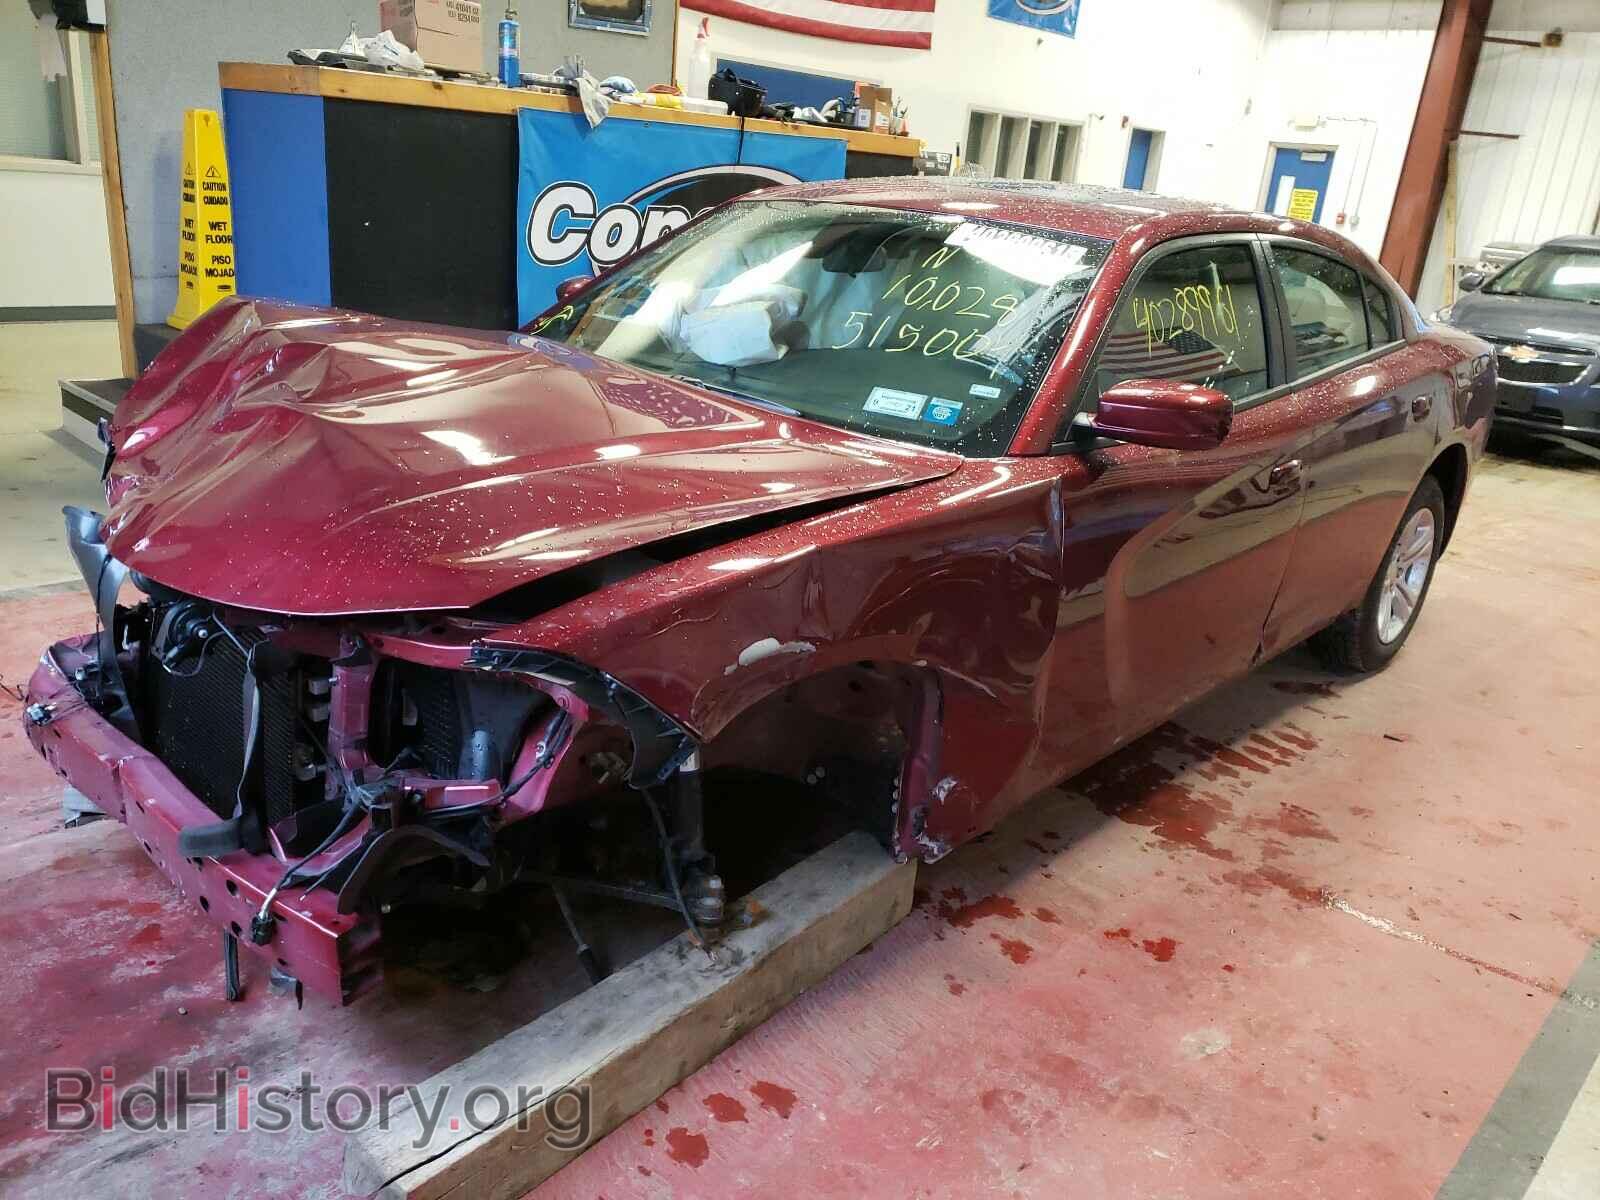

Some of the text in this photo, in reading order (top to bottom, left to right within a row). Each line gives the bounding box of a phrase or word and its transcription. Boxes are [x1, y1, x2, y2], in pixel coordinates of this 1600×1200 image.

[202, 182, 226, 191] CAUTION
[208, 221, 227, 231] WET
[211, 255, 231, 264] PISO
